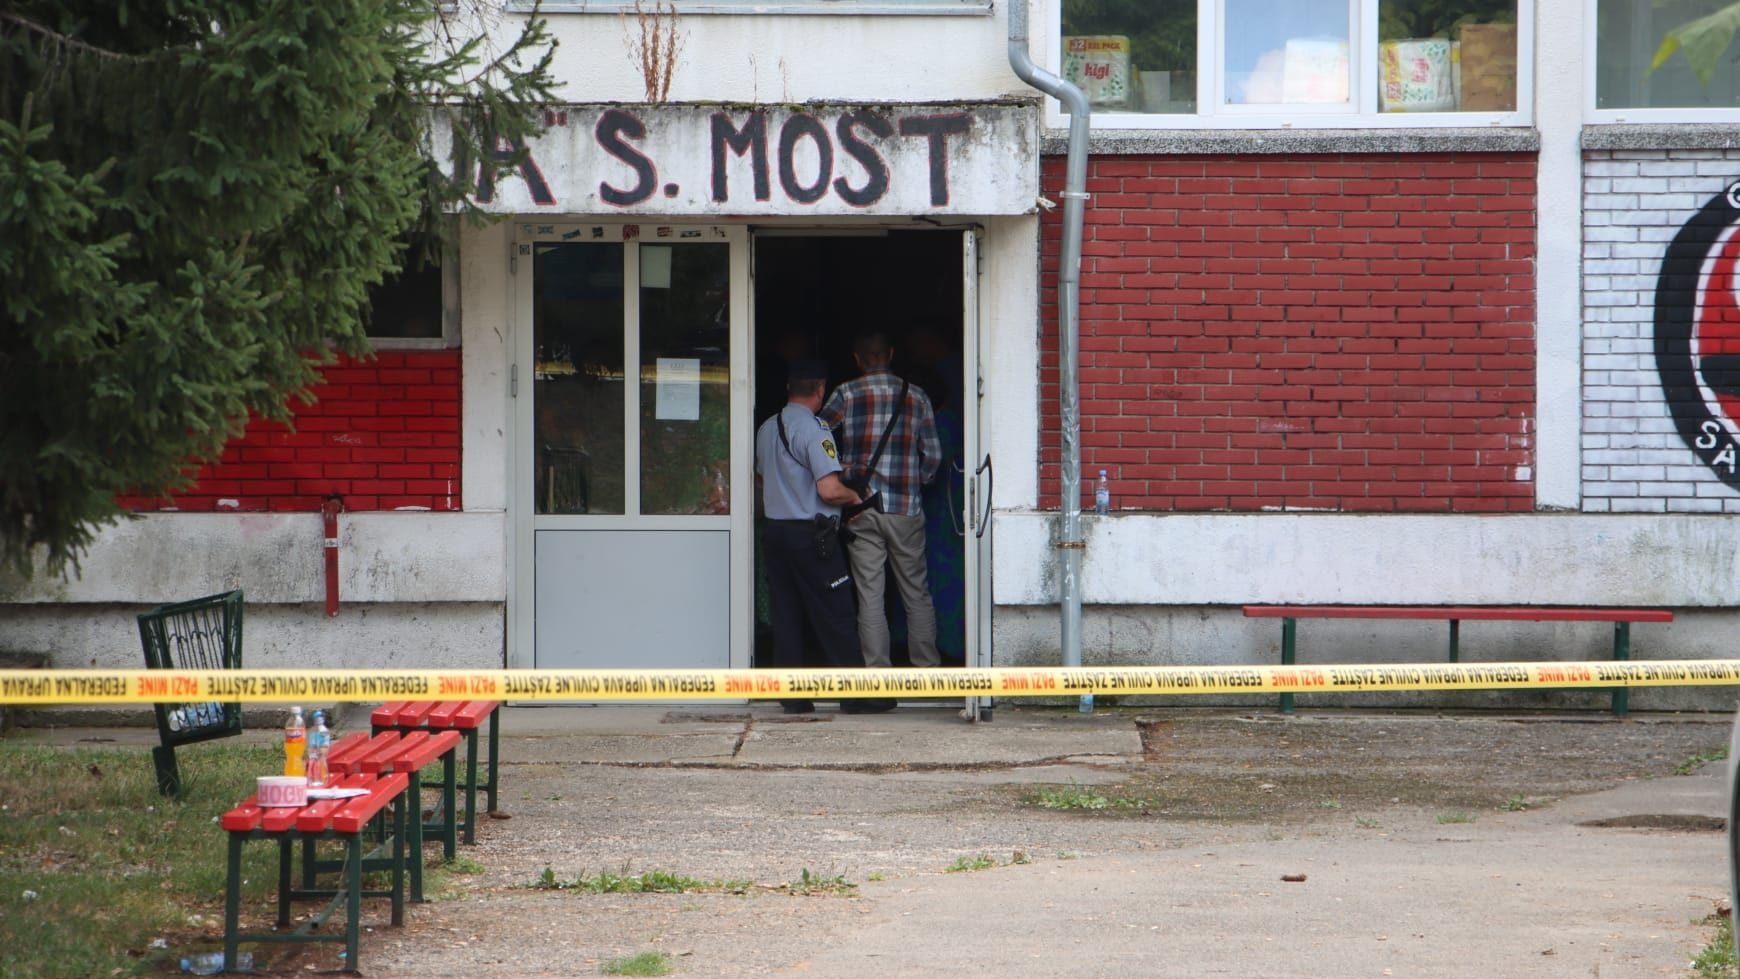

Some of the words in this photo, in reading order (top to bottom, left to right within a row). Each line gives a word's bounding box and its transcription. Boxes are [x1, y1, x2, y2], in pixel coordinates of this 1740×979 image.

[595, 108, 681, 206] S.
[709, 110, 975, 208] MOST
[1002, 672, 1029, 690] MINE
[1032, 671, 1055, 690] PAZI
[1110, 670, 1152, 689] CIVILNE
[1157, 670, 1197, 689] UPRAVA
[1202, 669, 1262, 688] FEDERALNA
[1269, 669, 1298, 687] MINE
[1301, 669, 1324, 687] PAZI
[1379, 667, 1420, 685] CIVILNE
[1425, 666, 1465, 684] UPRAVA
[1469, 665, 1529, 683] FEDERALNA
[1539, 665, 1564, 682] MINE
[1568, 665, 1591, 682] PAZI
[1645, 663, 1686, 681] CIVILNE
[1690, 663, 1730, 680] UPRAVA
[56, 676, 127, 696] FEDERALNA
[138, 676, 168, 696] MINE
[172, 676, 198, 696] PAZI
[261, 676, 307, 695] CIVILNE
[311, 676, 357, 695] UPRAVA
[361, 676, 428, 695] FEDERALNA
[439, 675, 468, 695] MINE
[471, 675, 496, 695] PAZI
[556, 675, 599, 694] CIVILNE
[603, 674, 647, 694] UPRAVA
[651, 674, 715, 693] FEDERALNA
[725, 674, 753, 693] MINE
[756, 673, 780, 692] PAZI
[837, 673, 880, 692] CIVILNE
[884, 673, 926, 691] UPRAVA
[930, 672, 992, 691] FEDERALNA
